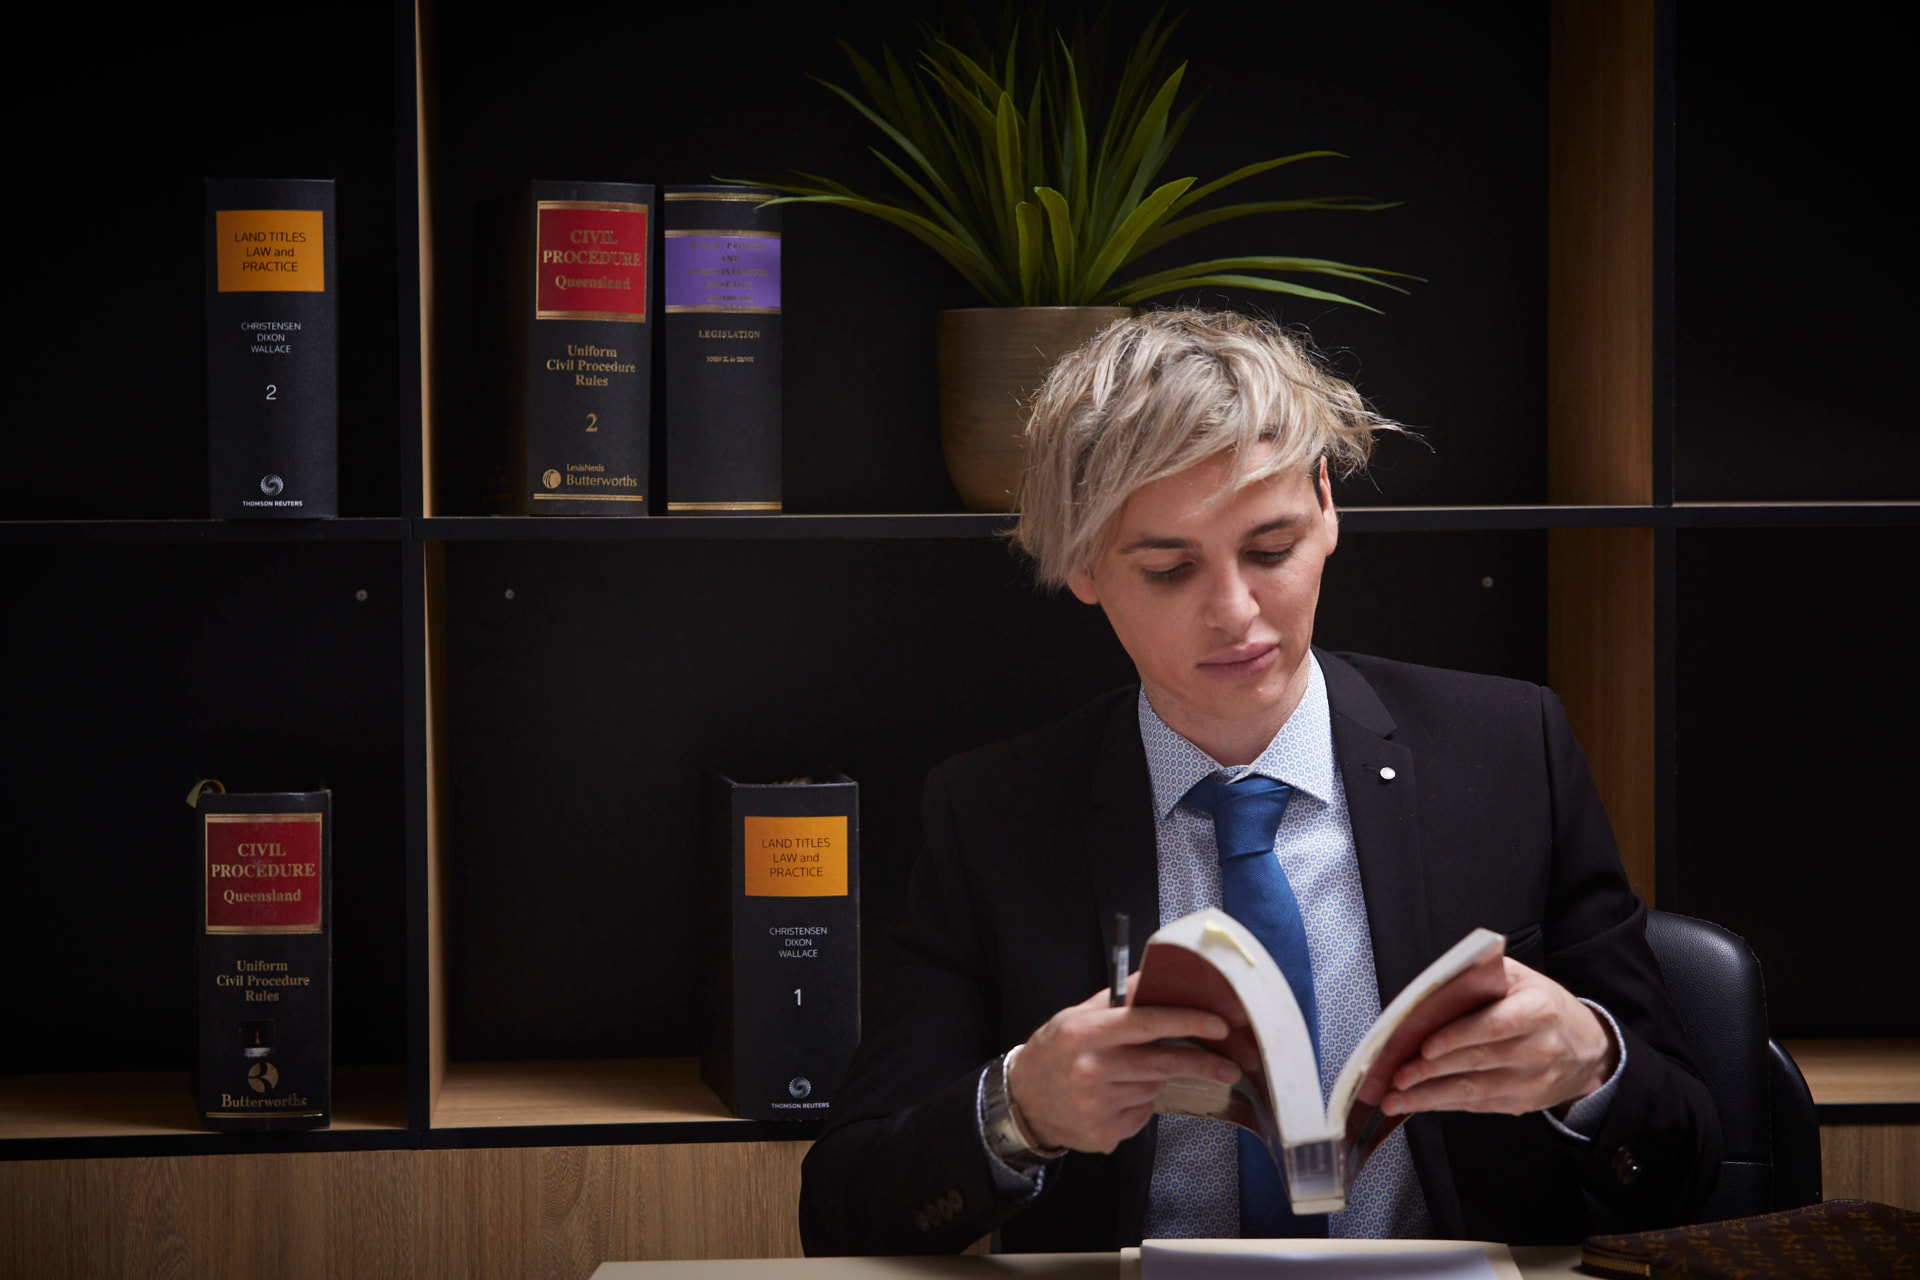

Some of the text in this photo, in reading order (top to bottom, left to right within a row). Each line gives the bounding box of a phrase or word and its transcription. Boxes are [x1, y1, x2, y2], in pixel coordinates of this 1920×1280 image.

[234, 232, 306, 243] LAND TITLES
[570, 230, 617, 244] CIVIL
[246, 248, 294, 257] LAW and
[542, 250, 642, 266] PROCEDURE
[242, 261, 298, 272] PRACTICE
[554, 275, 631, 290] Queensland
[241, 322, 301, 331] CHRISTENSEN
[257, 333, 285, 342] DIXON
[698, 330, 761, 338] LEGISLATION
[251, 345, 291, 353] WALLACE
[567, 345, 617, 358] Uniform
[546, 359, 636, 373] Civil Procedure
[575, 374, 609, 387] Rules
[266, 384, 277, 400] 2
[585, 413, 598, 432] 2
[566, 464, 605, 472] LexisNexis
[566, 474, 637, 487] Butterworths
[762, 838, 831, 849] LAND TITLES
[237, 843, 287, 857] CIVIL
[773, 853, 820, 863] LAW and
[211, 863, 316, 878] PROCEDURE
[770, 867, 823, 877] PRACTICE
[223, 889, 301, 904] Queensland
[769, 927, 828, 936] CHRISTENSEN
[785, 939, 812, 947] DIXON
[779, 950, 818, 958] WALLACE
[237, 960, 288, 972] Uniform
[216, 975, 310, 986] Civil Procedure
[245, 990, 280, 1002] Rules
[794, 988, 802, 1006] 1
[221, 1093, 308, 1108] Butterworths
